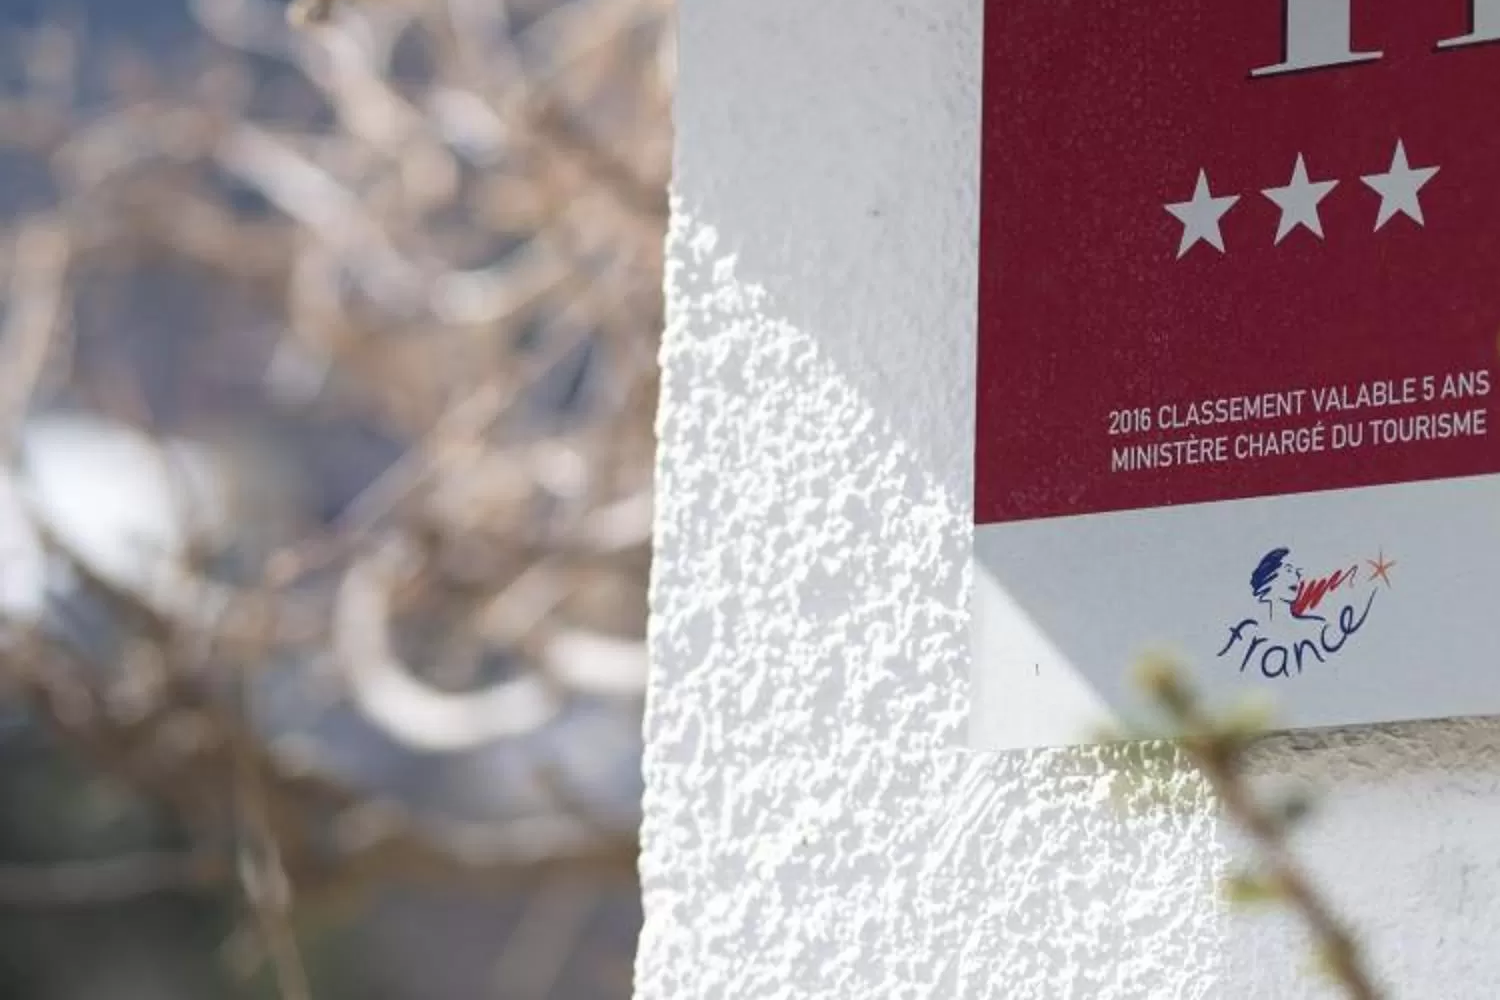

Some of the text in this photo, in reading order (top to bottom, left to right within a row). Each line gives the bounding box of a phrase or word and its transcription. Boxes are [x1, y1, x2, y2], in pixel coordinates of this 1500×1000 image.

[1107, 369, 1491, 436] 2016 CLASSEMENT VALABLE 5 ANS
[1111, 408, 1487, 473] MINISTÈRE CHARGÉ DU TOURISME
[1217, 586, 1378, 678] france
